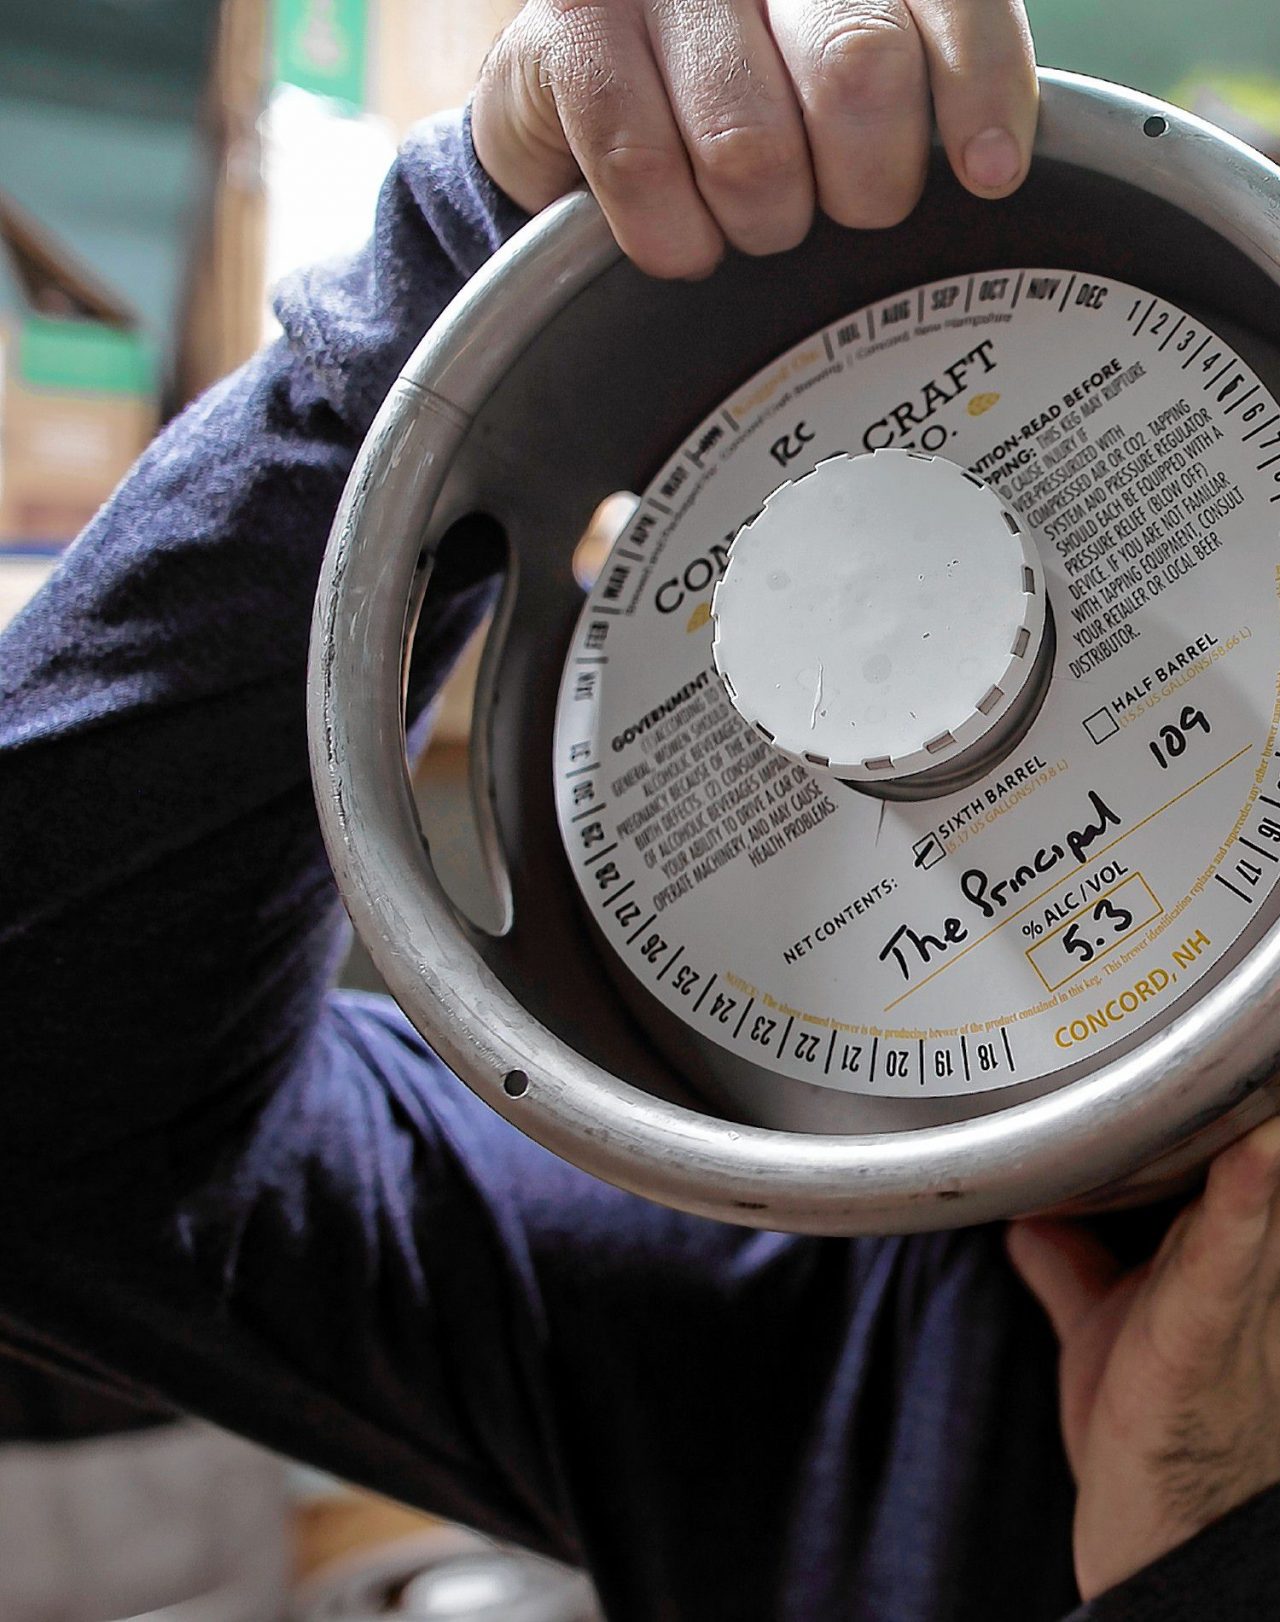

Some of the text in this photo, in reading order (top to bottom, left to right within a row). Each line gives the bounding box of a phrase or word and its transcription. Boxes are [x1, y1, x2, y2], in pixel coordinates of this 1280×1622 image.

[1074, 282, 1108, 309] DEC
[1126, 299, 1141, 321] 1
[1149, 311, 1169, 335] 2
[1176, 329, 1196, 351] 3
[1201, 352, 1221, 372] 4
[862, 340, 995, 452] CRAFT
[968, 358, 1121, 473] NTION-READ BEFORE
[983, 360, 1146, 485] PPING: THIS KEG MAY RUPTURE
[1241, 402, 1265, 422] 6
[907, 424, 957, 452] O.
[1011, 445, 1097, 512] VER-PRESSURIZED
[1094, 424, 1125, 451] WITH
[1026, 473, 1091, 528] COMPRESSED
[1090, 459, 1110, 482] AIR
[1106, 447, 1126, 467] OR
[1147, 398, 1190, 436] TAPPING
[1043, 407, 1212, 541] SYSTEM AND PRESSURE REGULATOR
[1055, 424, 1224, 557] SHOULD EACH BE EQUIPPED WITH A
[1063, 461, 1208, 576] PRESSURE RELIEF (BLOW OFF)
[1067, 471, 1230, 600] DEVICE. IF YOU ARE NOT FAMILIAR
[1070, 485, 1244, 623] WITH TAPPING EQUIPMENT, CONSULT
[1072, 531, 1223, 648] YOUR RETAILER OR LOCAL BEER
[1068, 623, 1140, 678] DISTRIBUTOR.
[1111, 633, 1218, 713] HALF BARREL
[611, 671, 712, 752] GOVERNMENT
[1150, 705, 1210, 768] 109
[1259, 725, 1277, 757] brewer
[1254, 757, 1268, 784] other
[938, 756, 1046, 839] SIXTH BARREL
[1247, 784, 1262, 802] any
[747, 795, 838, 867] HEALTH PROBLEMS.
[1212, 845, 1227, 865] and
[879, 791, 1121, 980] The Principal
[1189, 863, 1216, 896] replaces
[1235, 858, 1262, 886] 17
[614, 900, 641, 927] 27
[782, 878, 897, 964] NET CONTENTS:
[1144, 895, 1192, 941] identification
[1062, 899, 1133, 963] 5.3
[640, 933, 667, 963] 26
[1119, 937, 1148, 963] brewer
[671, 964, 700, 995] 25
[1101, 959, 1122, 975] This
[1055, 929, 1210, 1047] CONCORD, NH
[1056, 991, 1069, 1003] in
[1067, 983, 1085, 997] this
[709, 992, 736, 1023] 24
[1018, 994, 1059, 1019] contained
[750, 1015, 776, 1045] 23
[958, 1023, 969, 1036] of
[969, 1021, 983, 1033] the
[984, 1012, 1017, 1033] product
[793, 1032, 820, 1062] 22
[840, 1044, 862, 1072] 21
[977, 1043, 998, 1071] 18
[885, 1049, 909, 1077] 20
[934, 1049, 953, 1077] 19
